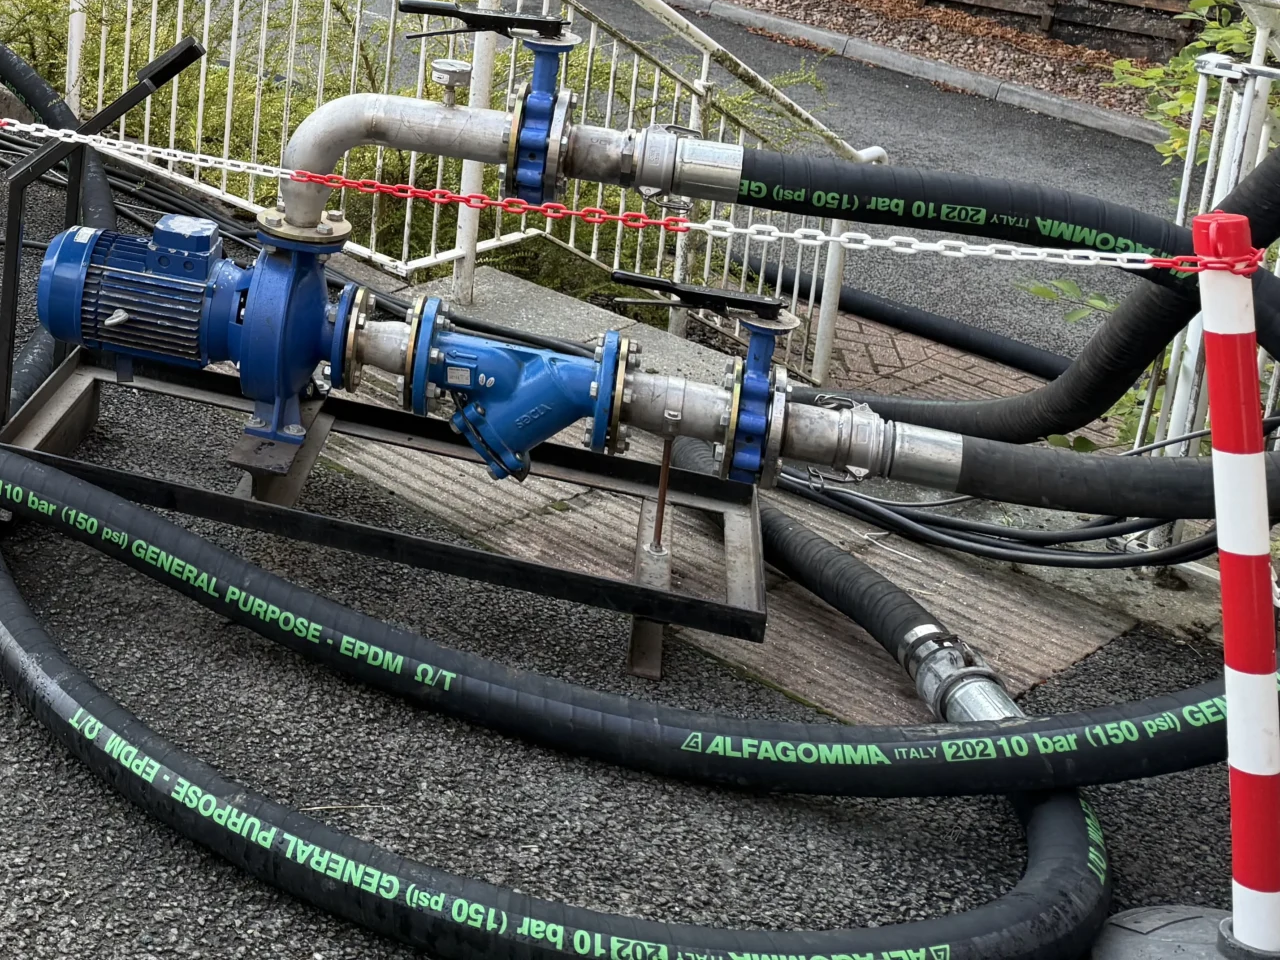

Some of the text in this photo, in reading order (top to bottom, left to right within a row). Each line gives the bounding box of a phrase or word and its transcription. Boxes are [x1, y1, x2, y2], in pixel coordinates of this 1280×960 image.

[773, 184, 805, 202] psi)
[812, 190, 859, 211] (150
[866, 196, 905, 216] bar
[911, 201, 937, 219] 10
[942, 204, 985, 225] 202
[990, 212, 1030, 228] ITALY
[4, 484, 23, 503] 10
[27, 492, 57, 517] bar
[61, 506, 98, 535] (150
[101, 526, 129, 550] psi)
[131, 539, 220, 598] GENERAL
[224, 585, 323, 644] PURPOSE
[339, 635, 404, 674] EPDM
[705, 735, 892, 765] ALFAGOMMA
[894, 746, 938, 760] ITALY
[942, 737, 997, 762] 202
[997, 736, 1029, 758] 10
[1033, 733, 1078, 754] bar
[1085, 720, 1139, 747] (150
[1142, 711, 1181, 738] psi)
[103, 733, 162, 784] EPDM
[170, 777, 277, 849] PURPOSE
[282, 832, 400, 900] GENERAL
[405, 883, 445, 911] psi)
[451, 898, 508, 935] (150
[517, 916, 564, 950] bar
[573, 930, 607, 957] 10
[611, 936, 668, 960] 202
